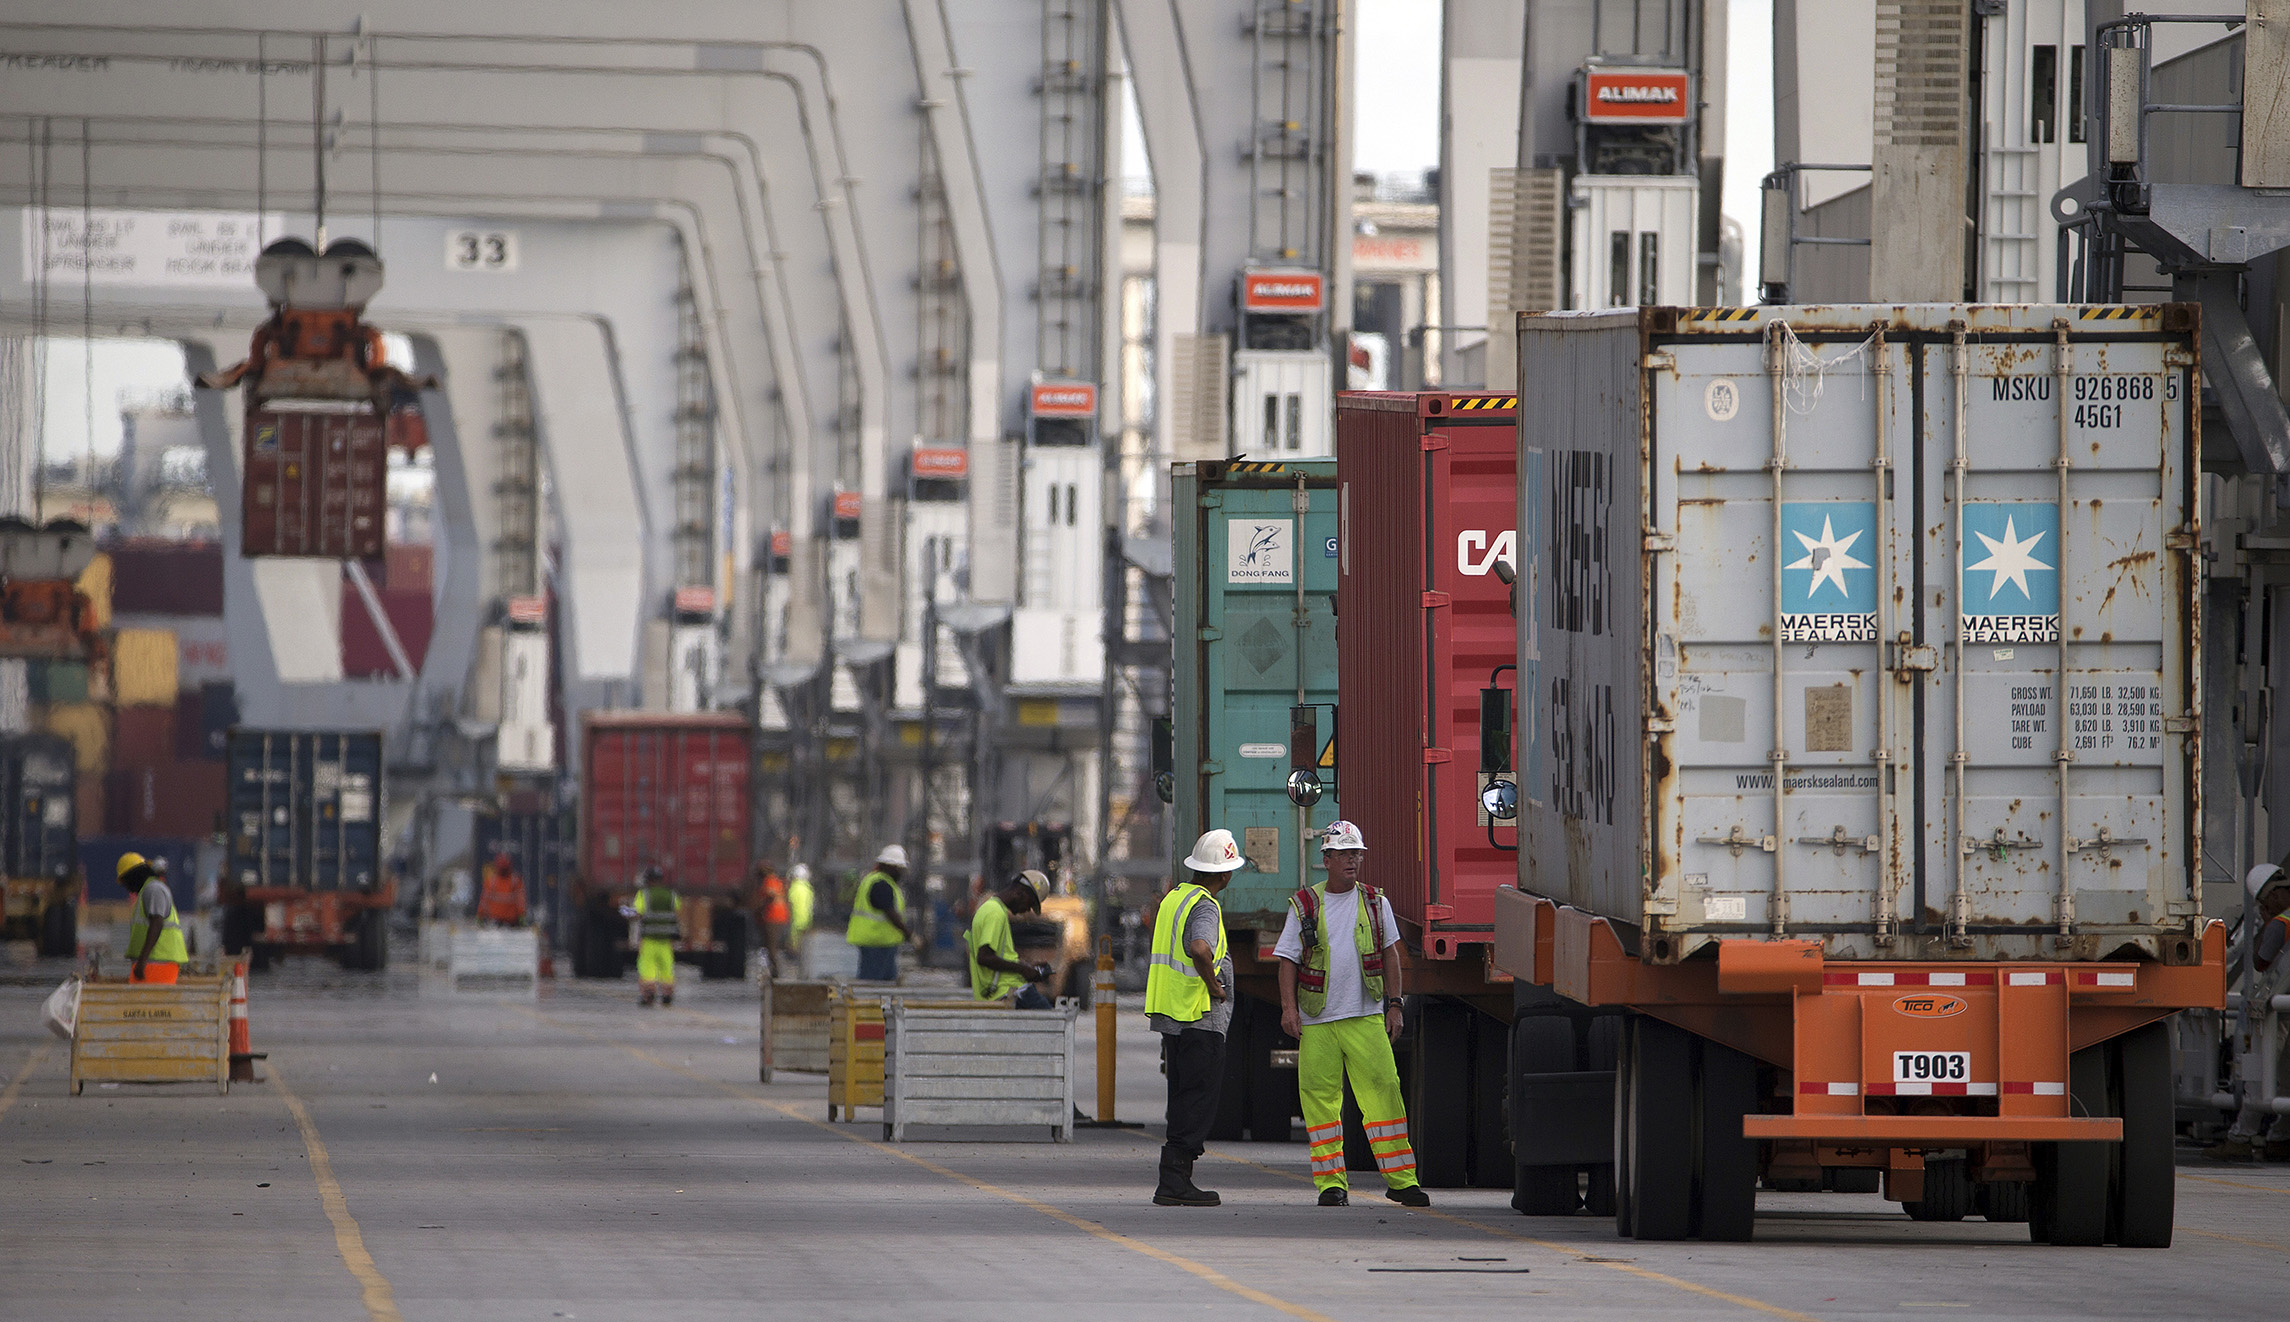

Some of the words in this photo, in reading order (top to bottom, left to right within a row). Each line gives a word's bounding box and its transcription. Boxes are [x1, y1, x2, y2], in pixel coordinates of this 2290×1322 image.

[1597, 86, 1678, 102] ALIMAK
[456, 234, 505, 264] 33
[1253, 283, 1316, 297] ALIMAK
[1993, 376, 2050, 401] MSKU
[2075, 376, 2153, 401] 926868
[2165, 376, 2177, 400] 5
[2075, 404, 2121, 428] 45G1
[1231, 570, 1260, 578] DONG
[1262, 570, 1290, 578] FANG
[1780, 614, 1878, 629] MAERSK
[1962, 616, 2060, 631] MAERSK
[1780, 629, 1878, 641] SEALAND
[1962, 631, 2060, 642] SEALAND
[2011, 687, 2037, 700] GROSS
[2039, 687, 2053, 700] WT.
[2070, 686, 2097, 700] 71,650
[2102, 686, 2113, 699] LB.
[2118, 686, 2145, 700] 32,500
[2150, 686, 2162, 699] KG.
[2011, 703, 2046, 716] PAYLOAD
[2070, 703, 2097, 717] 63,030
[2102, 703, 2113, 716] LB.
[2118, 703, 2145, 717] 28,590
[2150, 703, 2162, 716] KG.
[2011, 720, 2031, 733] TARE
[2033, 720, 2047, 733] WT.
[2075, 720, 2098, 734] 8,620
[2102, 720, 2113, 733] LB.
[2122, 720, 2145, 734] 3,910
[2150, 720, 2162, 733] KG.
[2012, 736, 2032, 749] CUBE
[2075, 736, 2097, 750] 2,691
[2128, 736, 2145, 749] 76.2
[1783, 773, 1878, 788] maersksealand.com
[1899, 1054, 1964, 1079] T903
